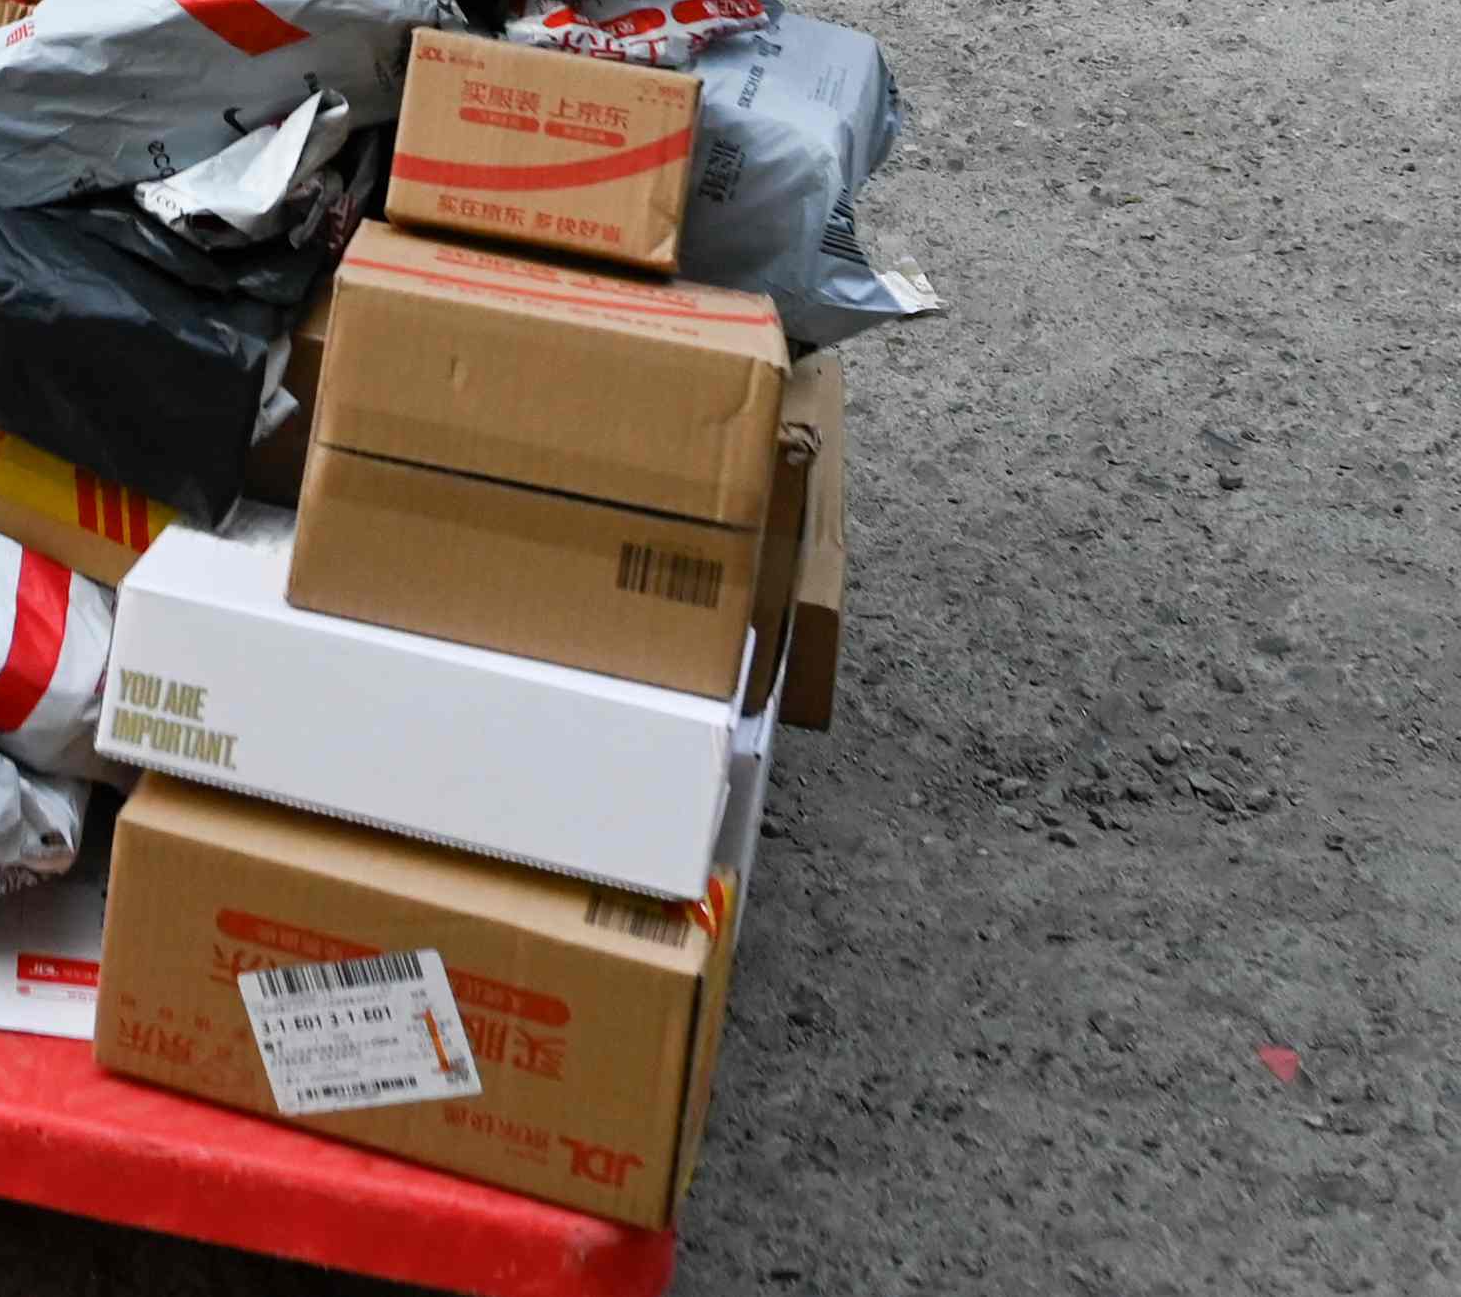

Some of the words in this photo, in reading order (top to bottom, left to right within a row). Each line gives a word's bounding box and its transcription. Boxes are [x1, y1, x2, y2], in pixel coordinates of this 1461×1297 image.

[460, 79, 542, 116] 买服装
[548, 96, 631, 130] 上京东
[437, 193, 526, 227] 买在京东
[116, 667, 160, 711] YOU
[164, 677, 207, 720] ARE
[110, 711, 240, 771] IMPORTANT.
[560, 1136, 645, 1189] JDL
